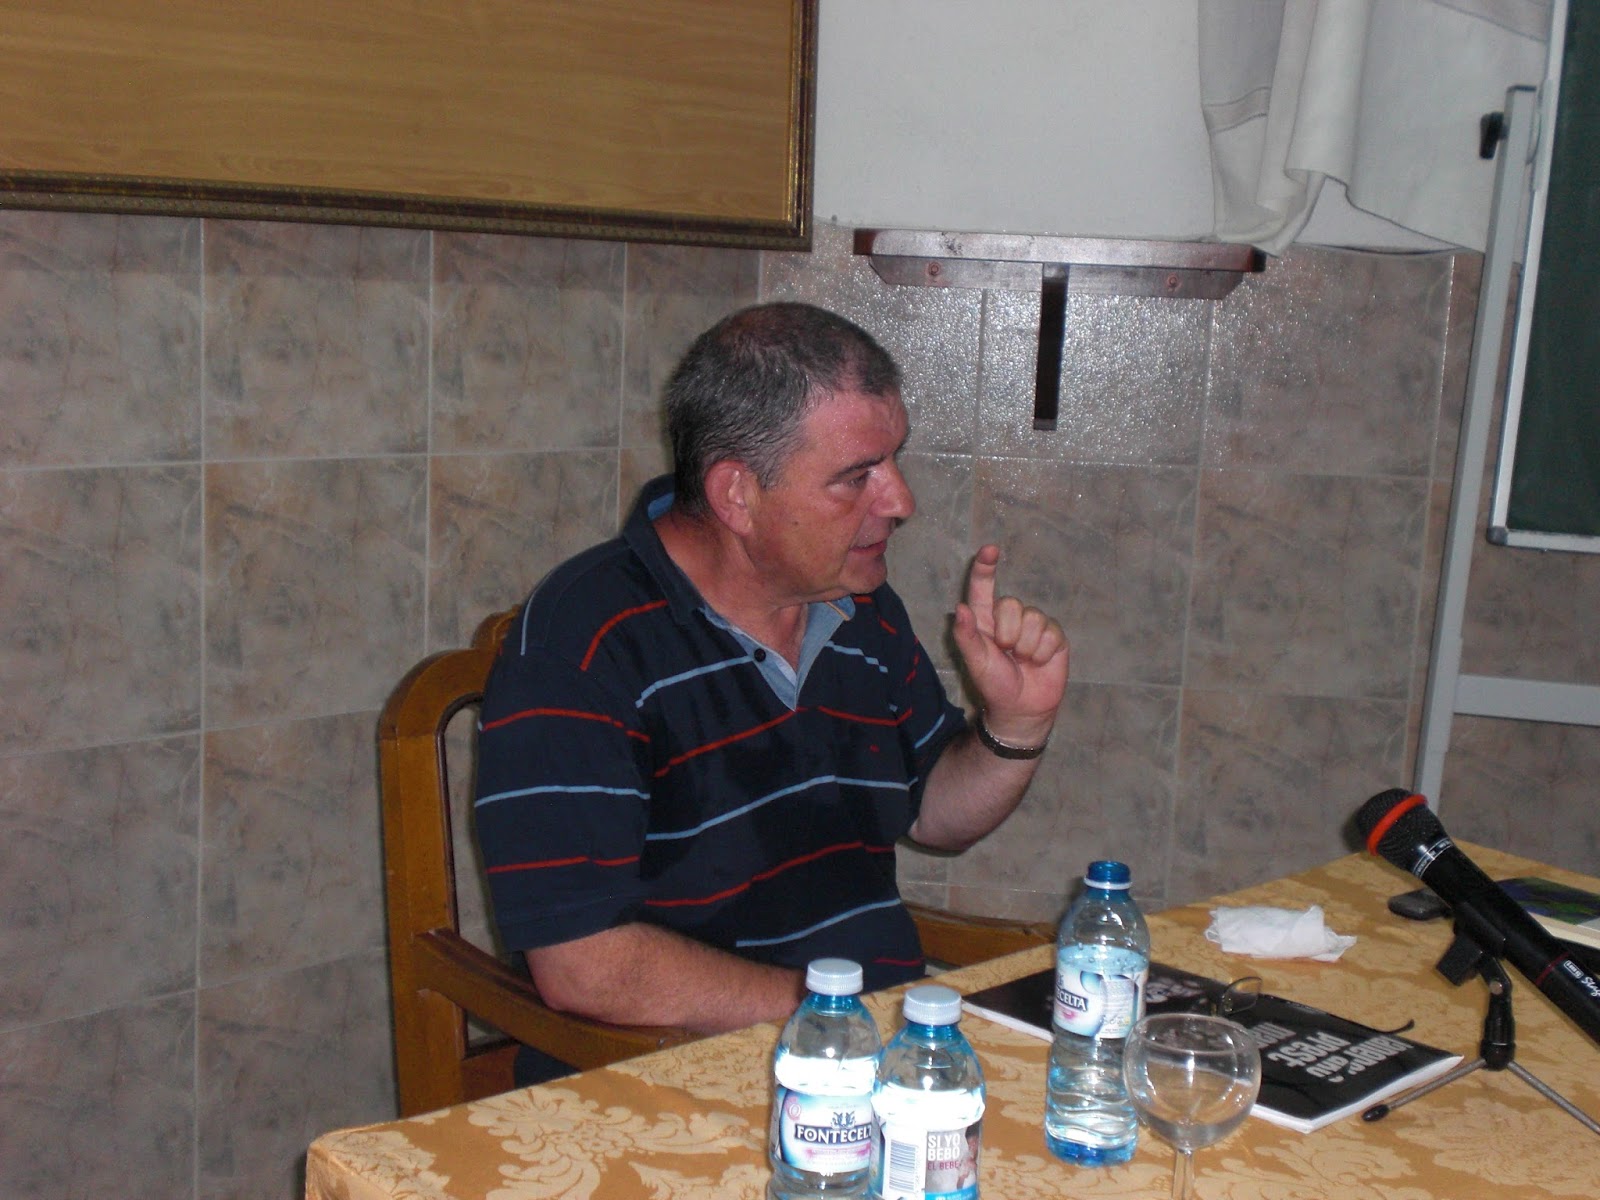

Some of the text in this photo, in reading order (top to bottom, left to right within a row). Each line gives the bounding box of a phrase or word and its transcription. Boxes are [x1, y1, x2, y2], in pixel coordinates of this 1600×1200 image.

[927, 1133, 961, 1149] SI YO
[927, 1146, 961, 1162] BEBO
